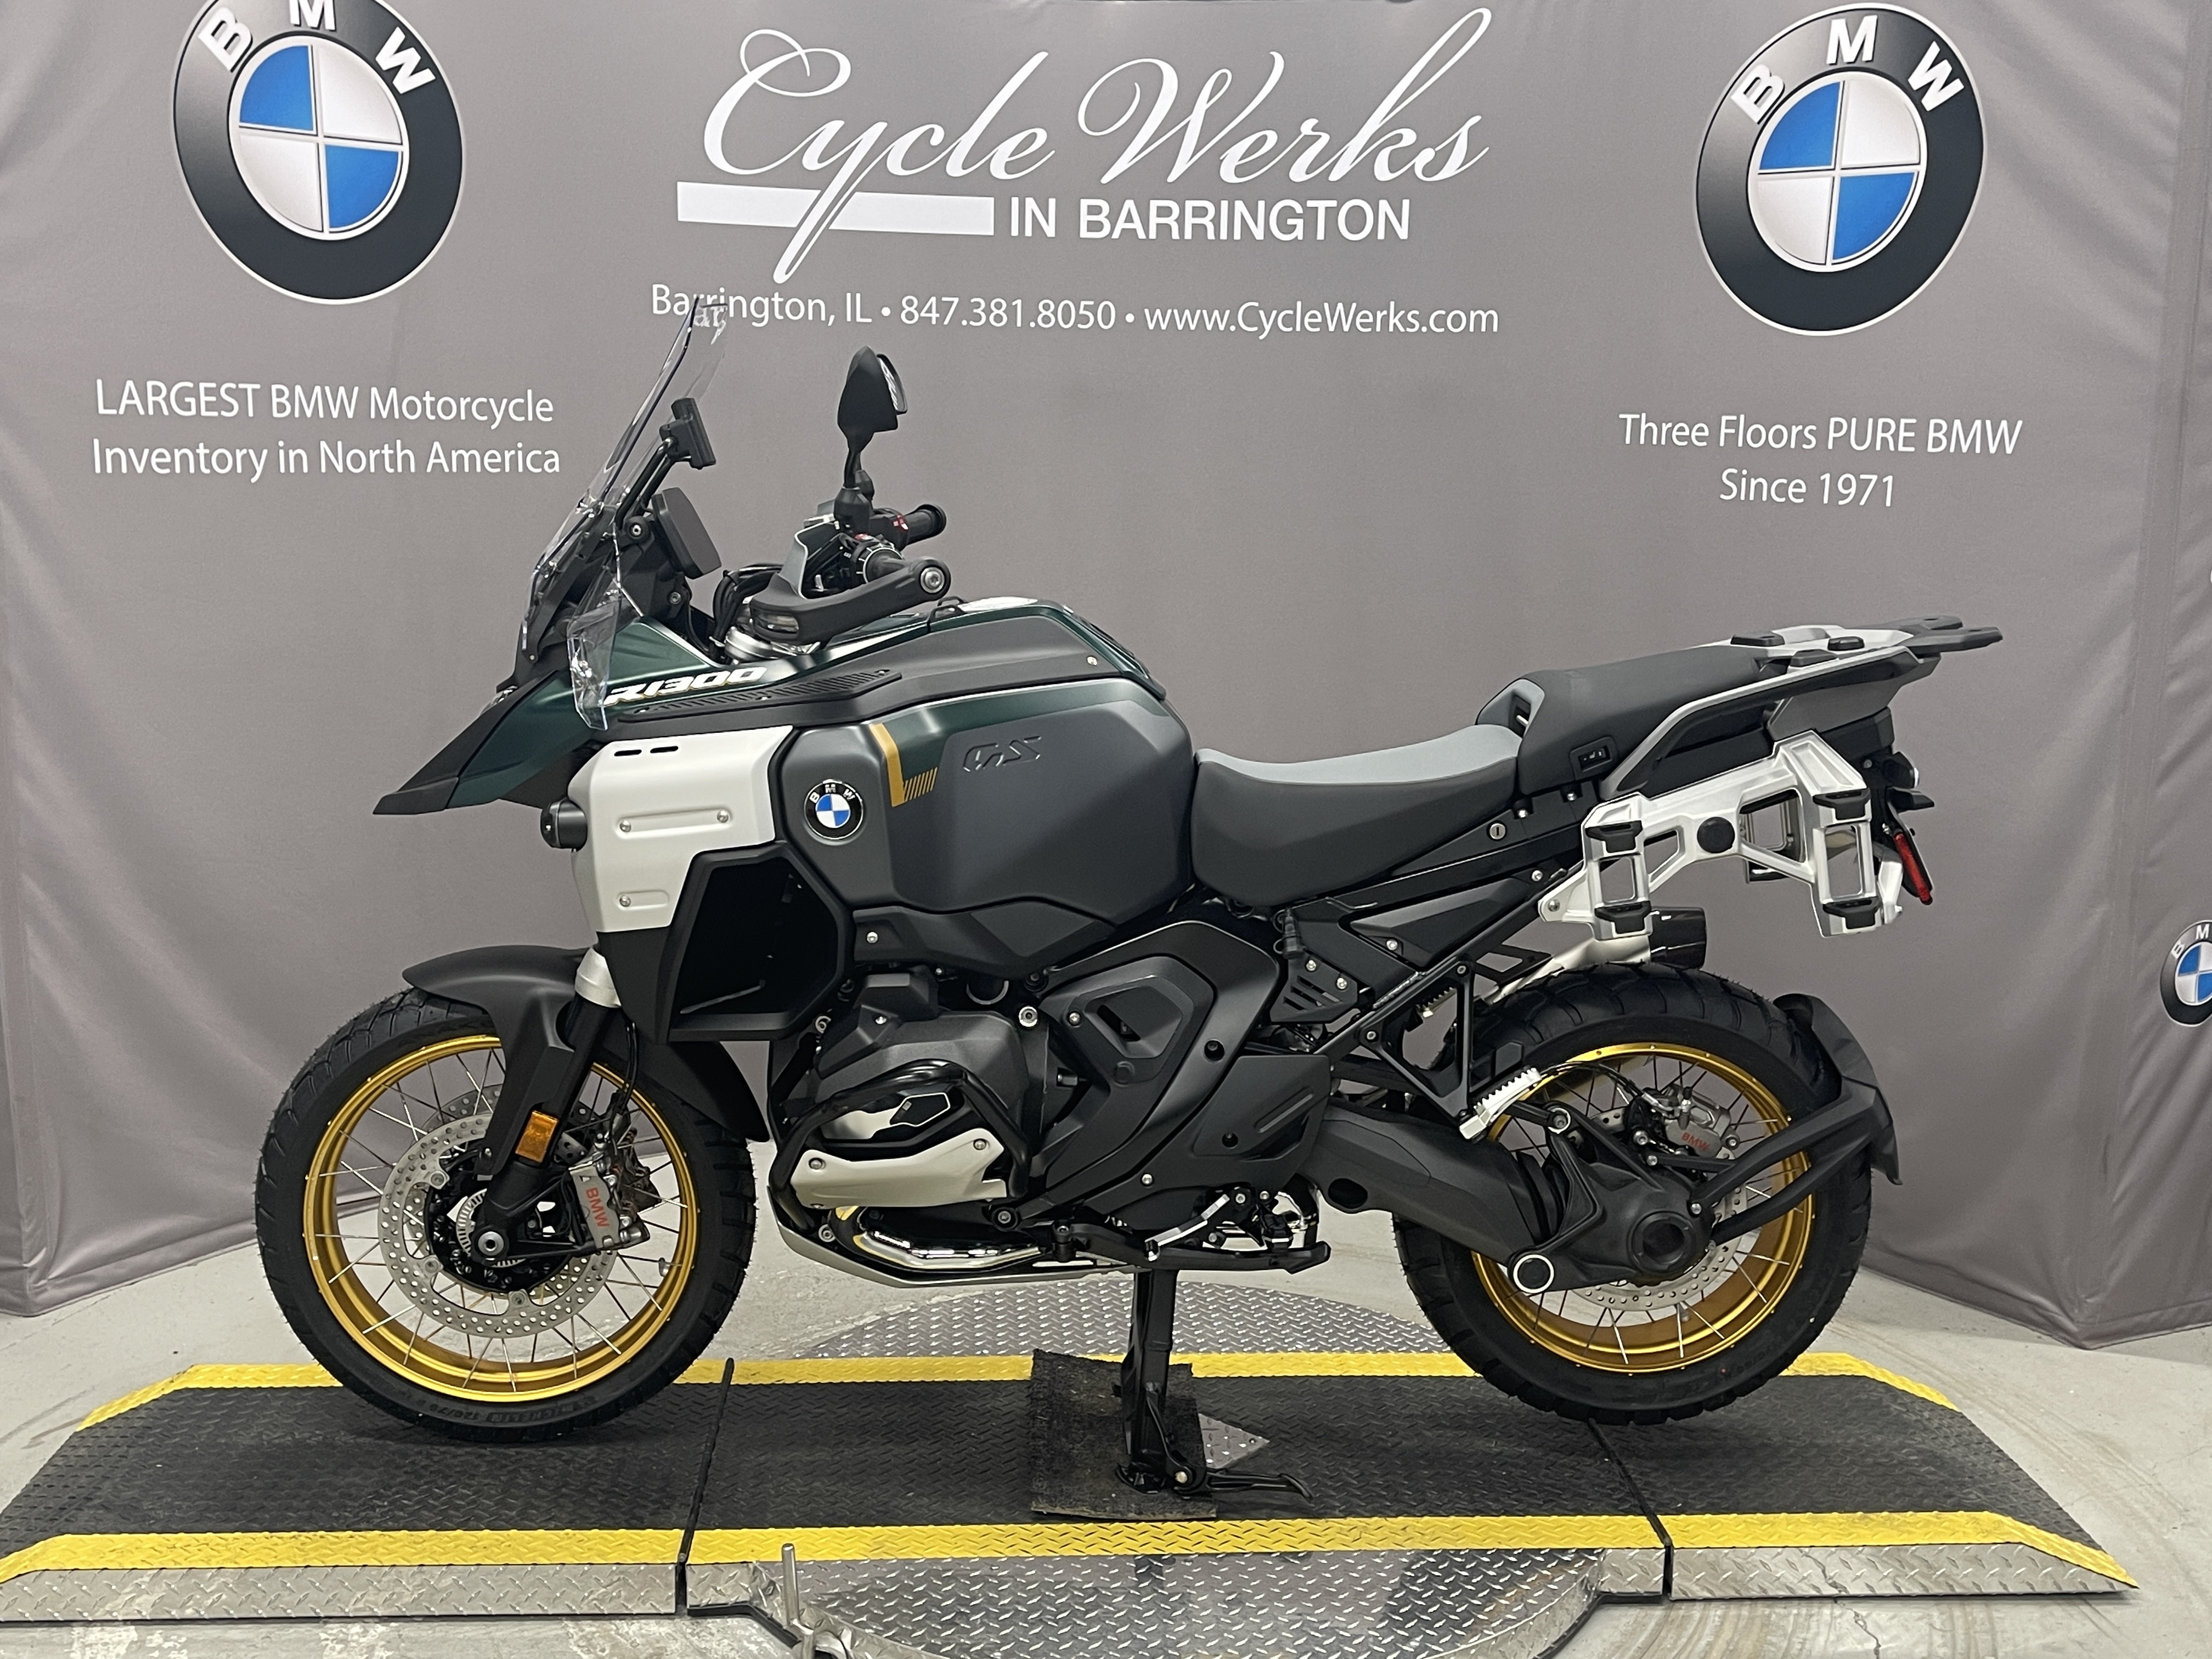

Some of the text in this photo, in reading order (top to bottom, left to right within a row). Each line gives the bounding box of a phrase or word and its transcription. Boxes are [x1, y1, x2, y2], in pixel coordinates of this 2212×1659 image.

[199, 0, 436, 94] BMW
[1731, 15, 1965, 123] BMW
[704, 8, 1492, 283] Cycle Werks
[1011, 196, 1410, 241] IN BARRINGTON
[846, 292, 872, 323] IL
[900, 295, 1116, 330] 847.381.8050
[1144, 301, 1498, 340] www.CycleWerks.com
[96, 379, 554, 430] LARGEST BMW Motorcycle
[1618, 413, 2023, 454] Three Floors PURE BMW
[93, 438, 561, 483] Inventory in North America
[1720, 468, 1895, 507] Since 1971
[809, 784, 856, 804] BMW
[2171, 924, 2210, 960] BM
[1681, 1132, 1711, 1150] BMW
[585, 1187, 611, 1228] BMW
